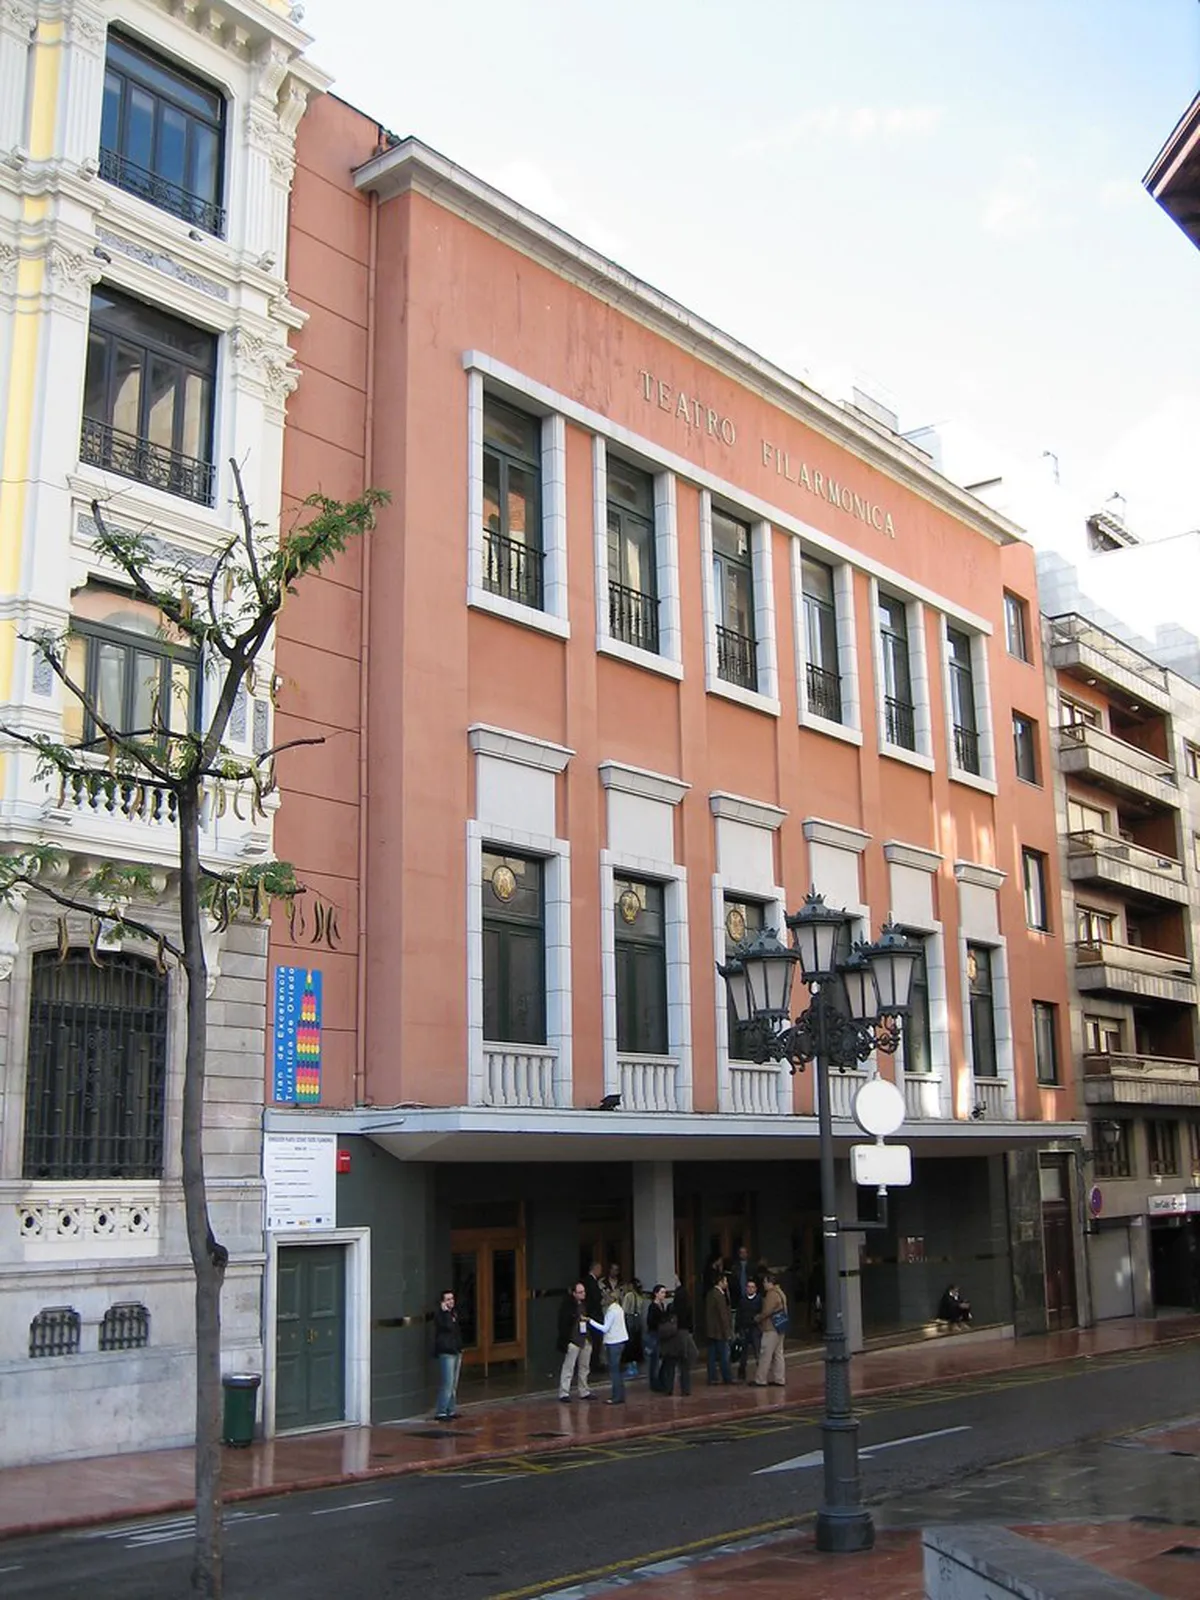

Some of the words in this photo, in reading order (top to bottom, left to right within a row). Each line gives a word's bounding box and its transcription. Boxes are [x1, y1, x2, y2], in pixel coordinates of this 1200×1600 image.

[639, 370, 736, 446] TEATRO
[761, 439, 896, 539] FILARMONICA
[277, 966, 285, 1039] Excelencia
[287, 967, 295, 1012] Oviedo
[287, 1020, 294, 1034] de
[278, 1046, 285, 1060] de
[276, 1071, 284, 1101] Plan
